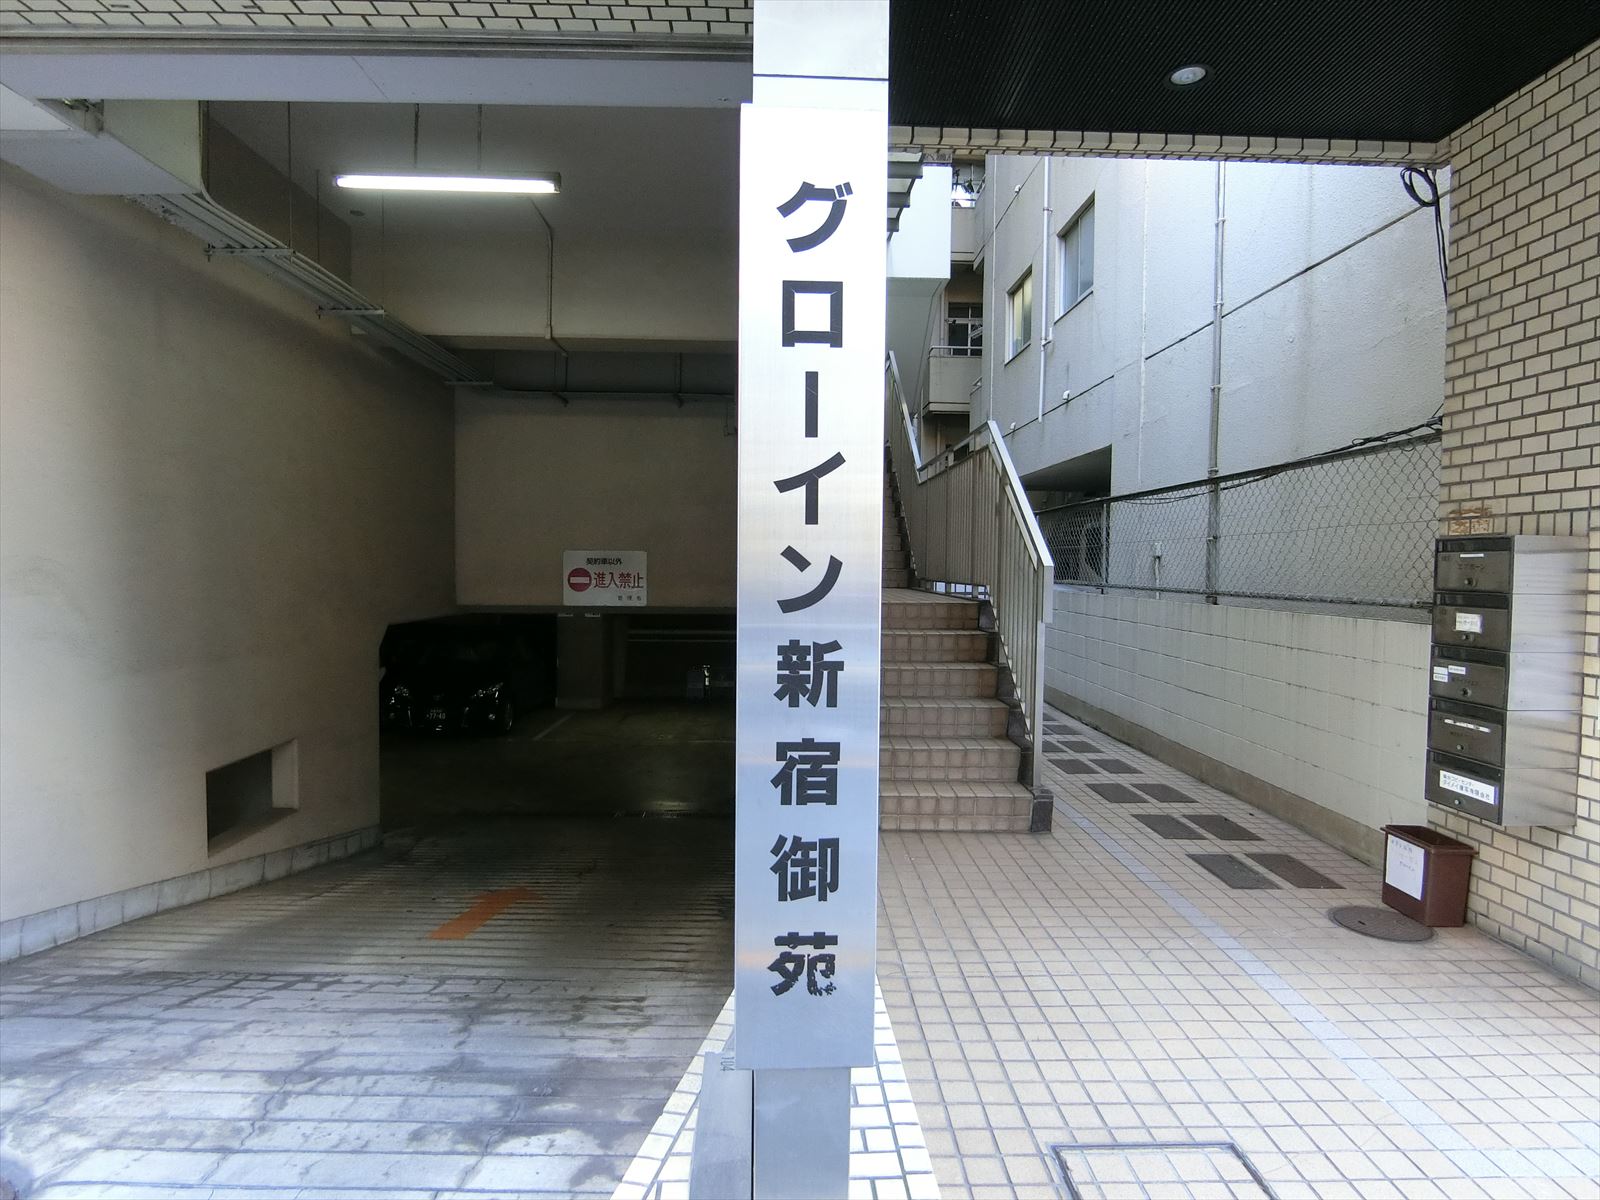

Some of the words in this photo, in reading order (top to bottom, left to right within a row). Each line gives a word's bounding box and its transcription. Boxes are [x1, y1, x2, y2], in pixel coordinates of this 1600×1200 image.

[593, 571, 645, 589] 進入禁止
[767, 181, 853, 997] グローイン新宿御苑
